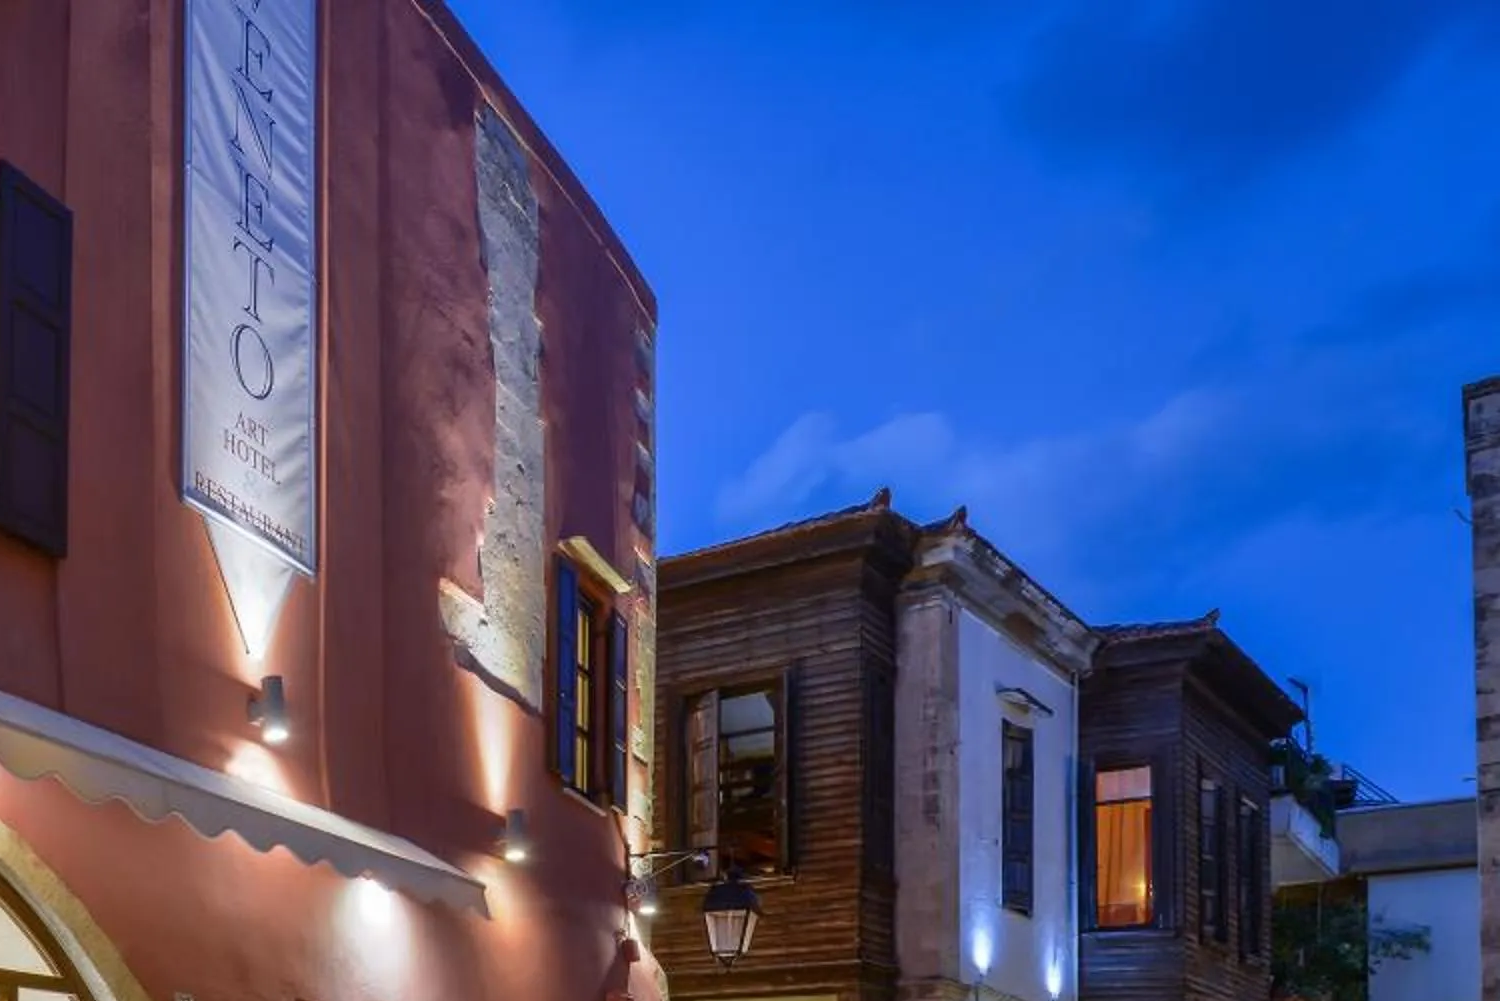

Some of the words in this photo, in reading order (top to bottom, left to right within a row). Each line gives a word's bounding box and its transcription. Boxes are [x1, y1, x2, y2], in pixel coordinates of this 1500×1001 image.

[230, 0, 276, 400] ENETO
[223, 428, 281, 486] HOTEL
[234, 411, 268, 447] ART
